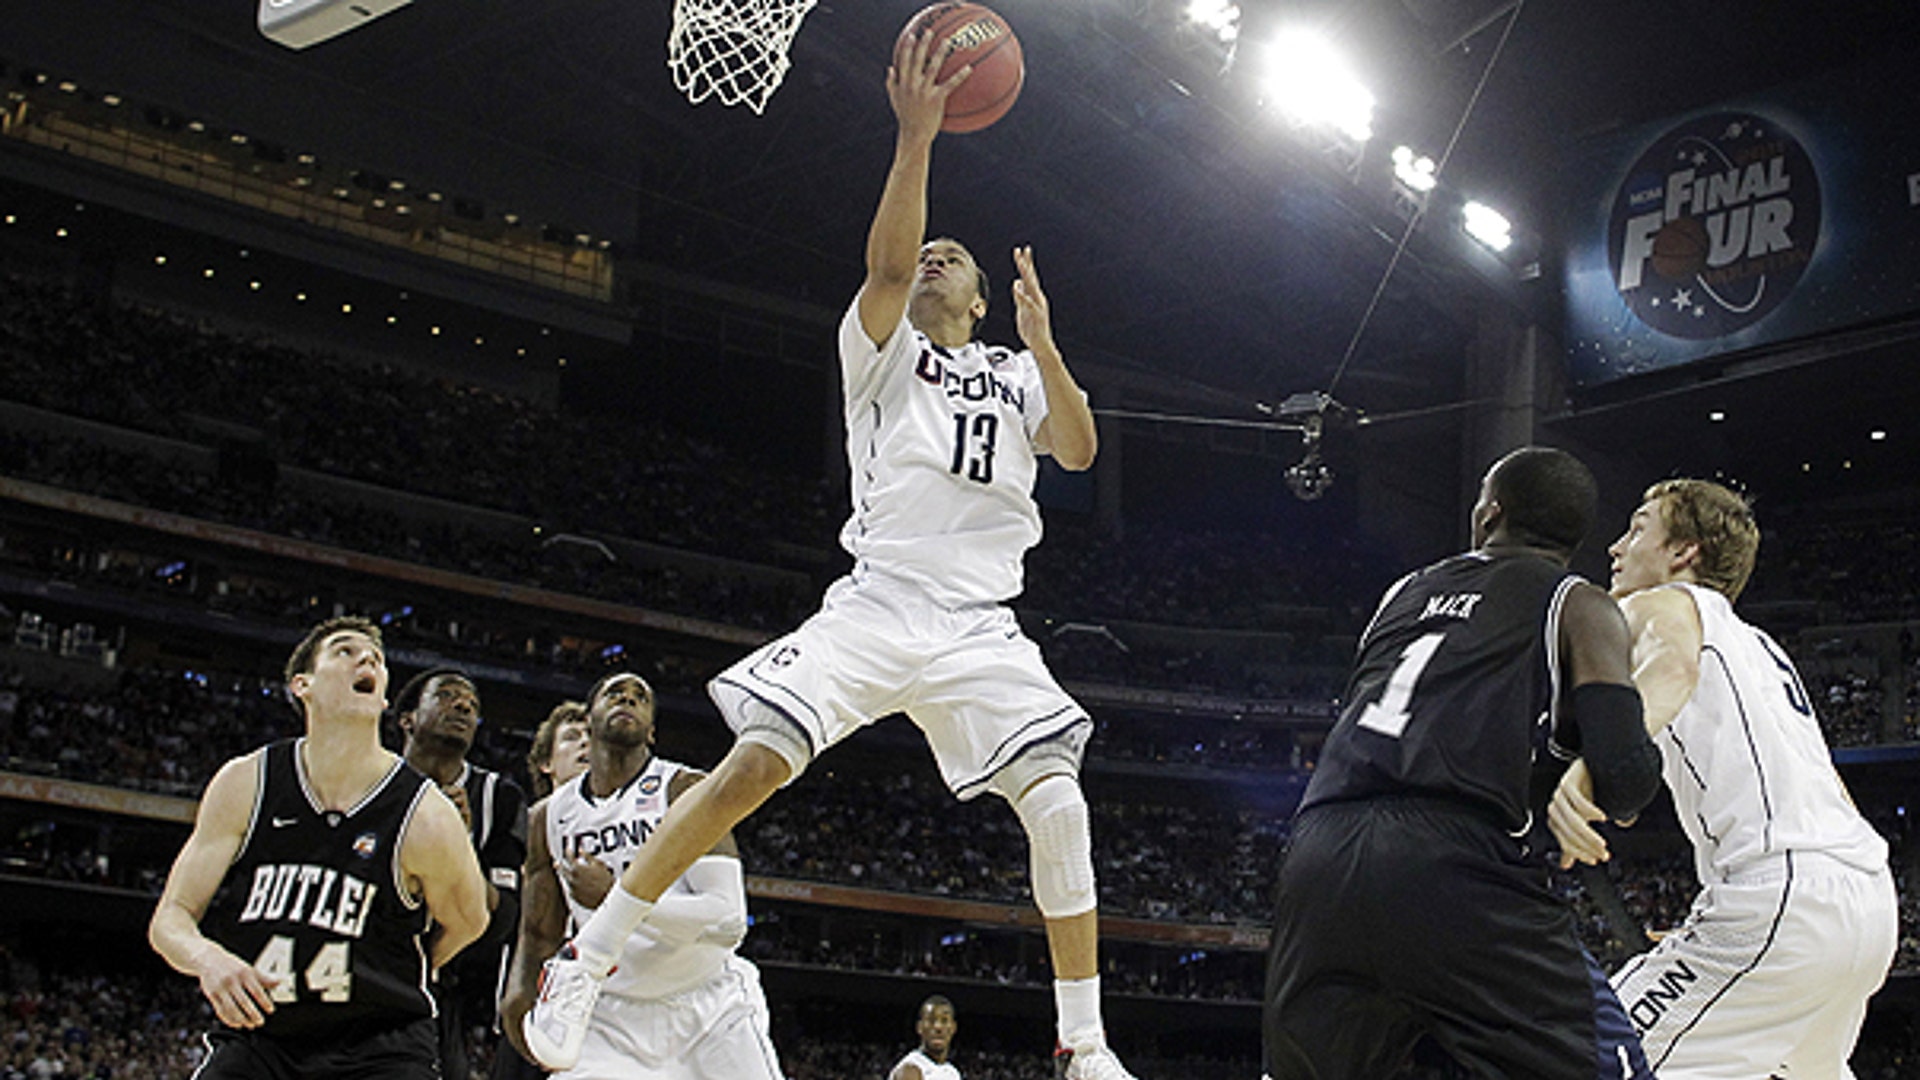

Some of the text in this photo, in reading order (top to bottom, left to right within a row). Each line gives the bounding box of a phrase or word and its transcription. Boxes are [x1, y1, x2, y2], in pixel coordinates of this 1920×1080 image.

[1665, 156, 1791, 221] FINAL
[1619, 198, 1795, 291] FOUR
[950, 413, 998, 484] 13
[1357, 632, 1448, 738] 1
[252, 935, 354, 1003] 44
[1629, 959, 1698, 1040] ONN
